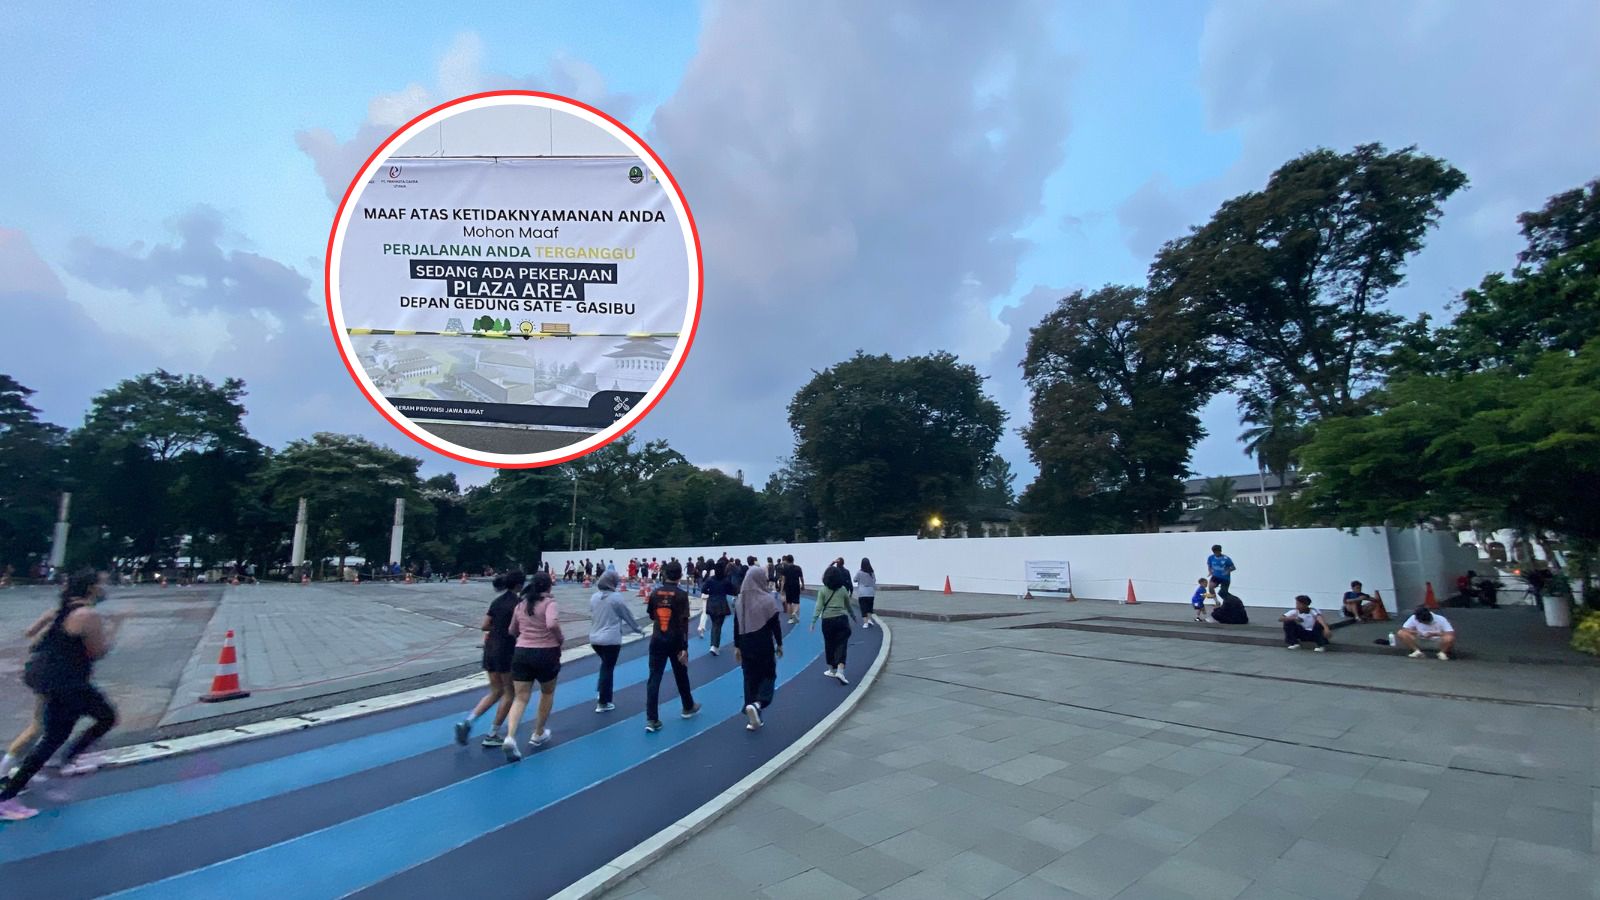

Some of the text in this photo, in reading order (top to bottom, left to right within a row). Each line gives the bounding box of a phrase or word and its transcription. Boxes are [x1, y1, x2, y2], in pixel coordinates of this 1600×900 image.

[364, 208, 666, 223] MAAF ATAS KETIDAKNYAMANAN ANDA
[463, 226, 559, 239] Mohon Maaf
[383, 243, 636, 260] PERJALANAN ANDA TERGANGGU
[416, 265, 612, 282] SEDANG ADA PEKERJAAN
[454, 280, 577, 299] PLAZA AREA
[400, 296, 450, 309] DEPAN
[454, 298, 519, 311] GEDUNG
[523, 300, 562, 312] SATE
[576, 301, 635, 315] GASIBU
[415, 405, 444, 413] PROVINSI
